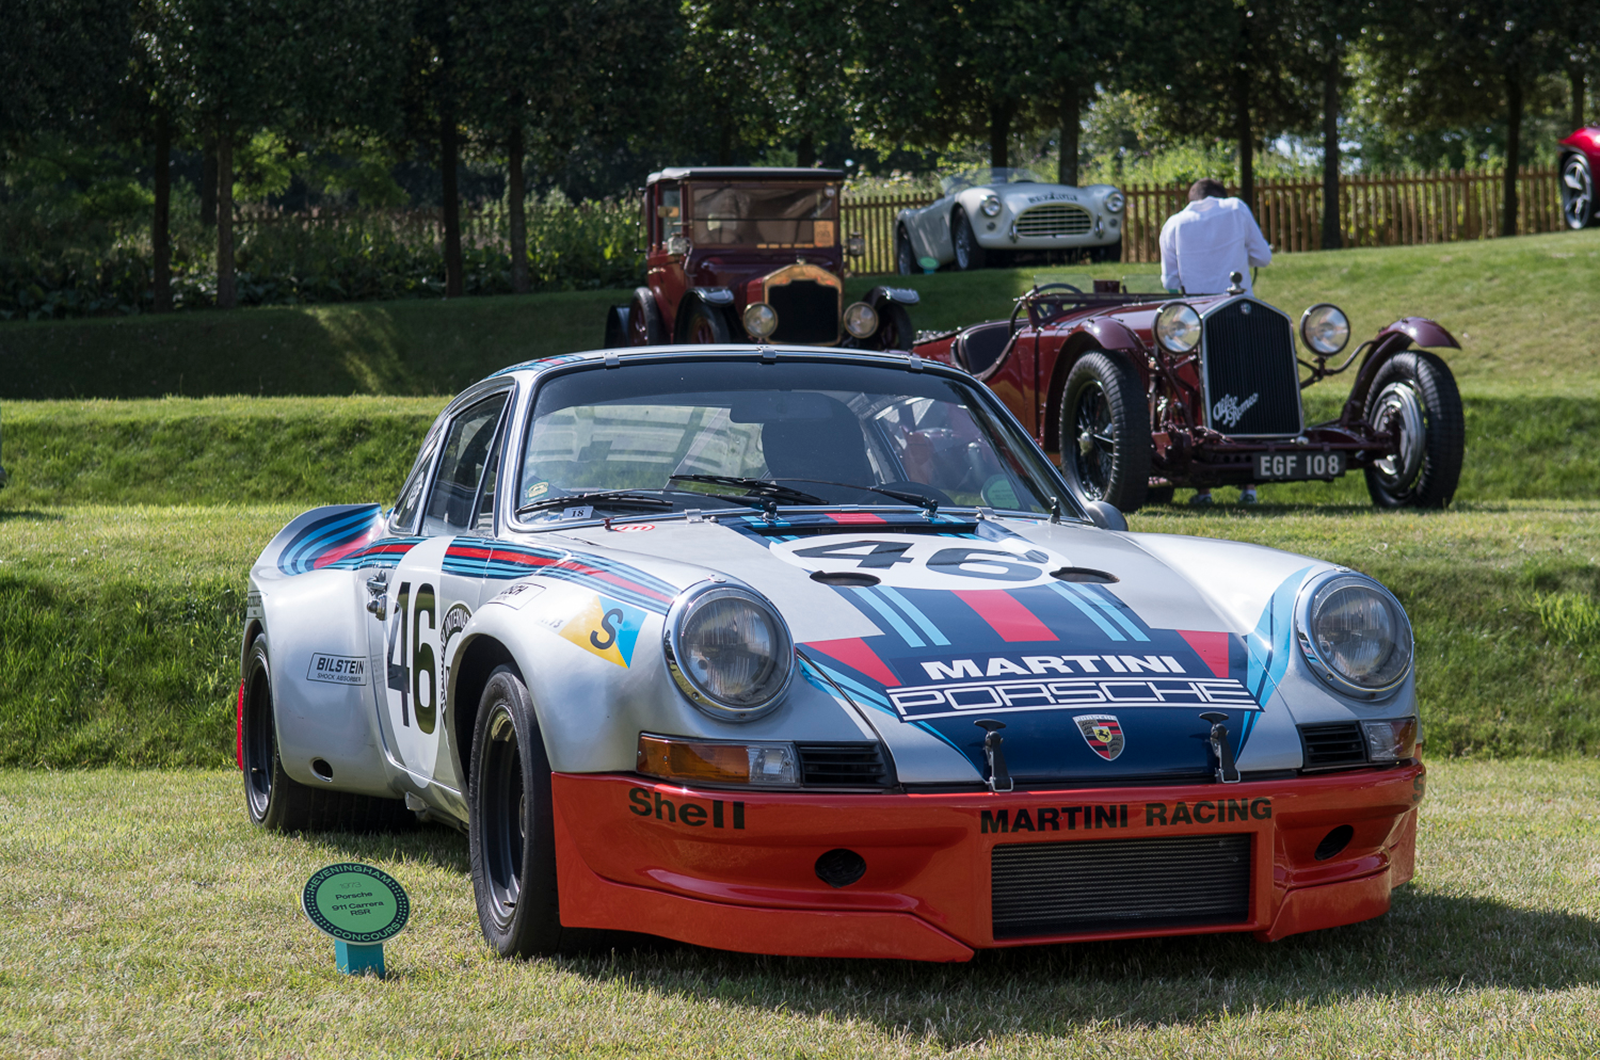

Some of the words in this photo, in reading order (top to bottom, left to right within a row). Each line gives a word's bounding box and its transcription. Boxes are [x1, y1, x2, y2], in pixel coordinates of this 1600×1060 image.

[1213, 394, 1238, 425] Alfa
[1228, 393, 1259, 428] Romeo
[1260, 455, 1297, 476] EGF
[1306, 455, 1339, 475] 108
[571, 509, 584, 517] 18
[792, 540, 1050, 582] 46
[590, 608, 624, 650] S
[317, 657, 365, 674] BILSTEIN
[387, 581, 437, 735] 46
[920, 655, 1187, 680] MARTINI
[317, 672, 335, 680] SHOCK
[890, 681, 1258, 716] PORSCHE
[629, 787, 745, 829] Shell
[980, 804, 1129, 834] MARTINI
[1145, 797, 1272, 827] RACING
[307, 865, 391, 891] HEVENINGHAM
[340, 881, 362, 889] 1973
[335, 891, 373, 900] Porsche
[349, 901, 384, 909] Carrera
[350, 908, 371, 916] RSR
[333, 921, 400, 941] CONCOURS
